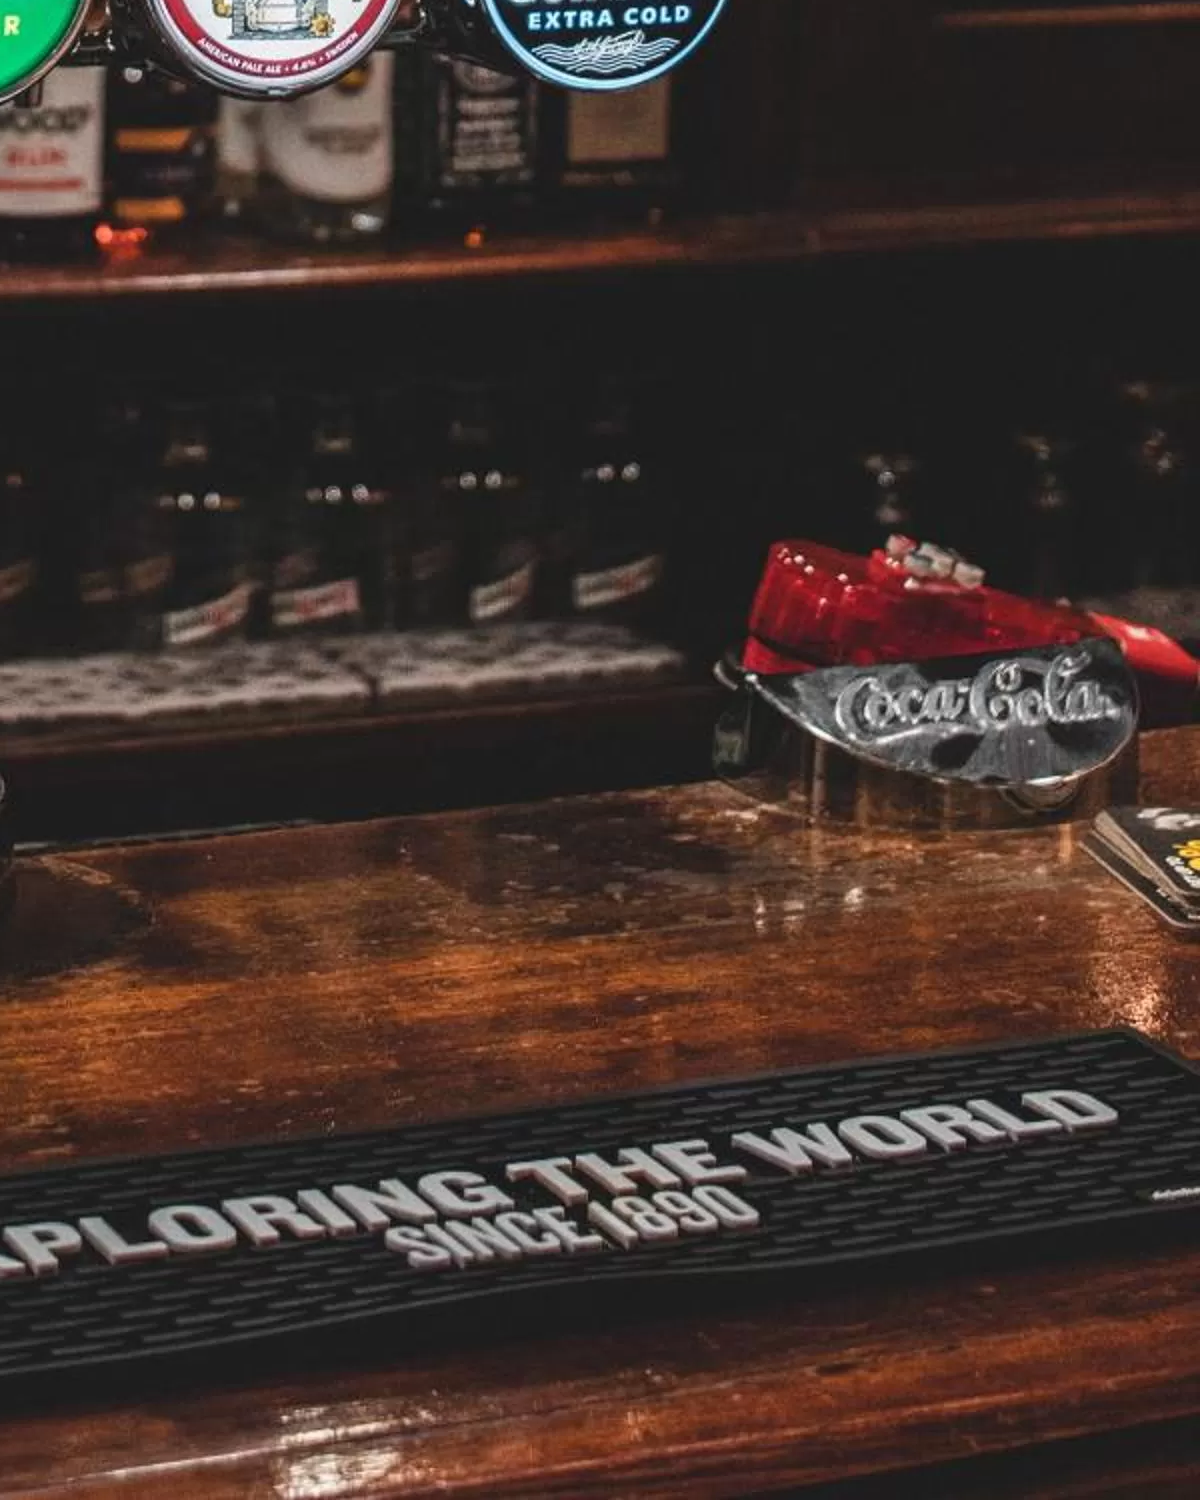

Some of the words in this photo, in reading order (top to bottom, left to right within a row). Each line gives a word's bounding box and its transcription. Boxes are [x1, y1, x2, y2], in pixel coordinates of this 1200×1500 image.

[527, 8, 615, 30] EXTRA
[623, 4, 691, 25] COLD
[198, 37, 241, 69] AMERICAN
[240, 59, 263, 74] PALE
[506, 1138, 747, 1206] THE
[731, 1088, 1119, 1177] WORLD
[385, 1204, 603, 1270] SINCE
[587, 1184, 761, 1250] 1890
